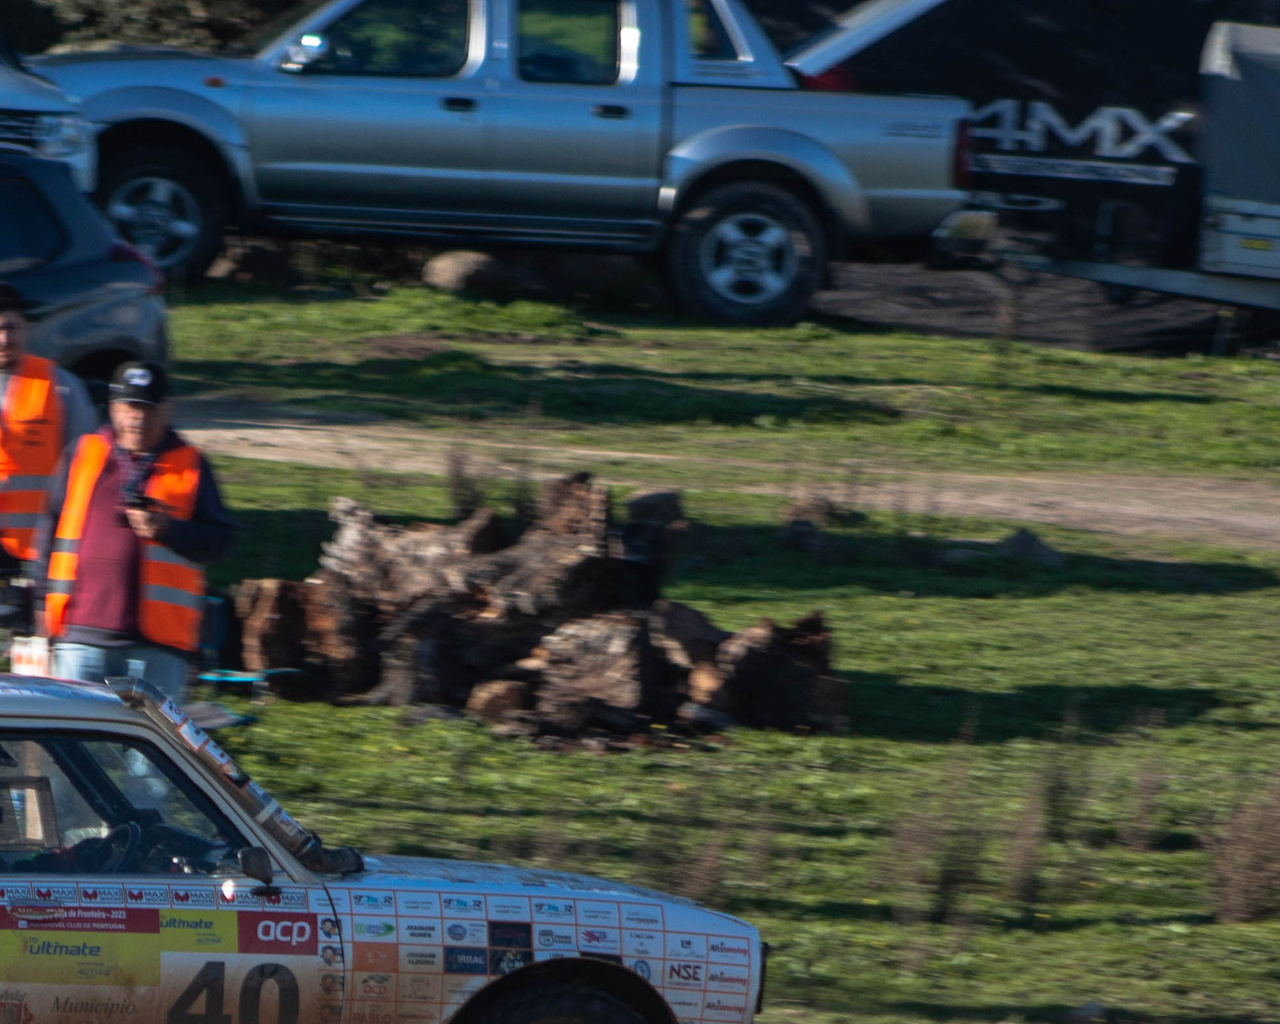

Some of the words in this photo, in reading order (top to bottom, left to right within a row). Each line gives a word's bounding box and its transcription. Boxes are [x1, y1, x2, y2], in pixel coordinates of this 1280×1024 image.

[160, 917, 213, 929] ultimate
[257, 920, 310, 946] acp
[29, 941, 101, 956] ultimate
[669, 964, 703, 982] NSE
